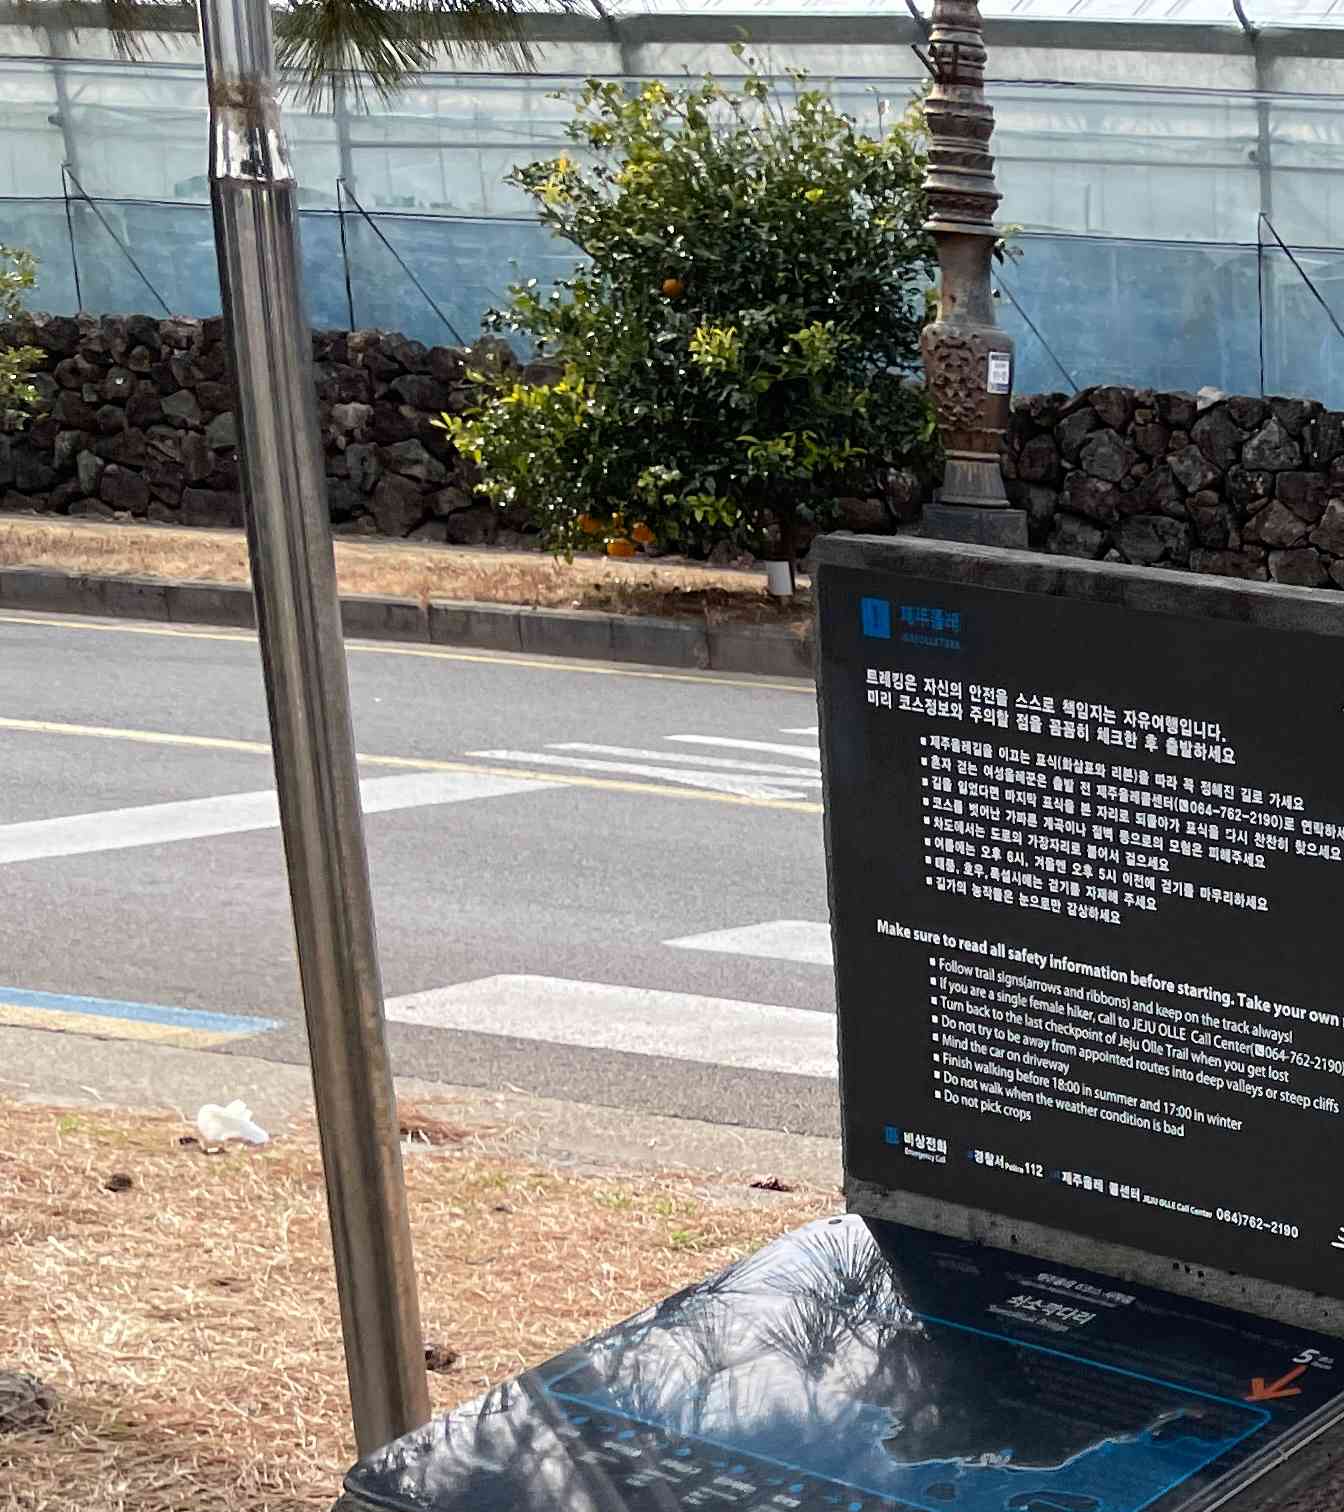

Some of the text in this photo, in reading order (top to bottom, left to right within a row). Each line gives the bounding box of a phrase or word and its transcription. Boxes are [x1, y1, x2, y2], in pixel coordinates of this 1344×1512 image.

[866, 668, 1226, 743] 트레킹은 자신의 안전을 스스로 책임지는 자유여행입니다.
[867, 689, 892, 709] 미리
[898, 694, 963, 721] 코스정보와
[969, 705, 1009, 728] 주의할
[1015, 713, 1043, 734] 점을
[1048, 718, 1089, 742] 꼼꼼히
[1096, 726, 1138, 749] 체크한
[1165, 736, 1236, 764] 출발하세요
[877, 918, 911, 939] Make
[913, 929, 941, 945] sure
[942, 933, 957, 948] to
[958, 938, 988, 955] read
[989, 942, 1006, 958] all
[1007, 947, 1048, 970] safety
[1049, 953, 1128, 983] information
[1130, 969, 1175, 993] before
[1177, 983, 1235, 1008] starting.
[1236, 992, 1271, 1013] Take
[1273, 1002, 1307, 1020] your
[1308, 1010, 1339, 1027] own
[938, 957, 974, 976] Follow
[974, 966, 995, 981] trail
[1063, 986, 1084, 1000] and
[1132, 1000, 1153, 1014] and
[1155, 1001, 1183, 1023] keep
[1184, 1011, 1199, 1024] on
[1200, 1012, 1220, 1028] the
[1221, 1017, 1250, 1035] track
[939, 995, 1289, 1083] Turn back the last checkpoint Jeju Olle Trail when you get lost
[948, 981, 968, 994] you
[970, 985, 986, 999] are
[996, 989, 1028, 1008] single
[1029, 994, 1065, 1015] female
[1097, 1011, 1116, 1026] call
[1131, 1017, 1156, 1034] JEJU
[1158, 1022, 1186, 1041] OLLE
[1190, 1029, 1211, 1046] Call
[941, 1014, 1339, 1113] Do not try be away from appointed routes into deep valleys steep cliffs
[942, 1033, 1070, 1075] Mind the car on driveway
[942, 1051, 972, 1071] Finish
[974, 1061, 1014, 1083] walking
[1015, 1067, 1050, 1088] before
[1052, 1076, 1080, 1095] 18:00
[1094, 1088, 1138, 1107] summer
[1139, 1098, 1160, 1113] and
[1206, 1112, 1243, 1130] winter
[943, 1070, 1184, 1137] Do not walk when the weather condition bad
[944, 1088, 1031, 1122] Do not pick crops
[1024, 1161, 1044, 1177] 112
[1216, 1207, 1299, 1239] 064)762-2190
